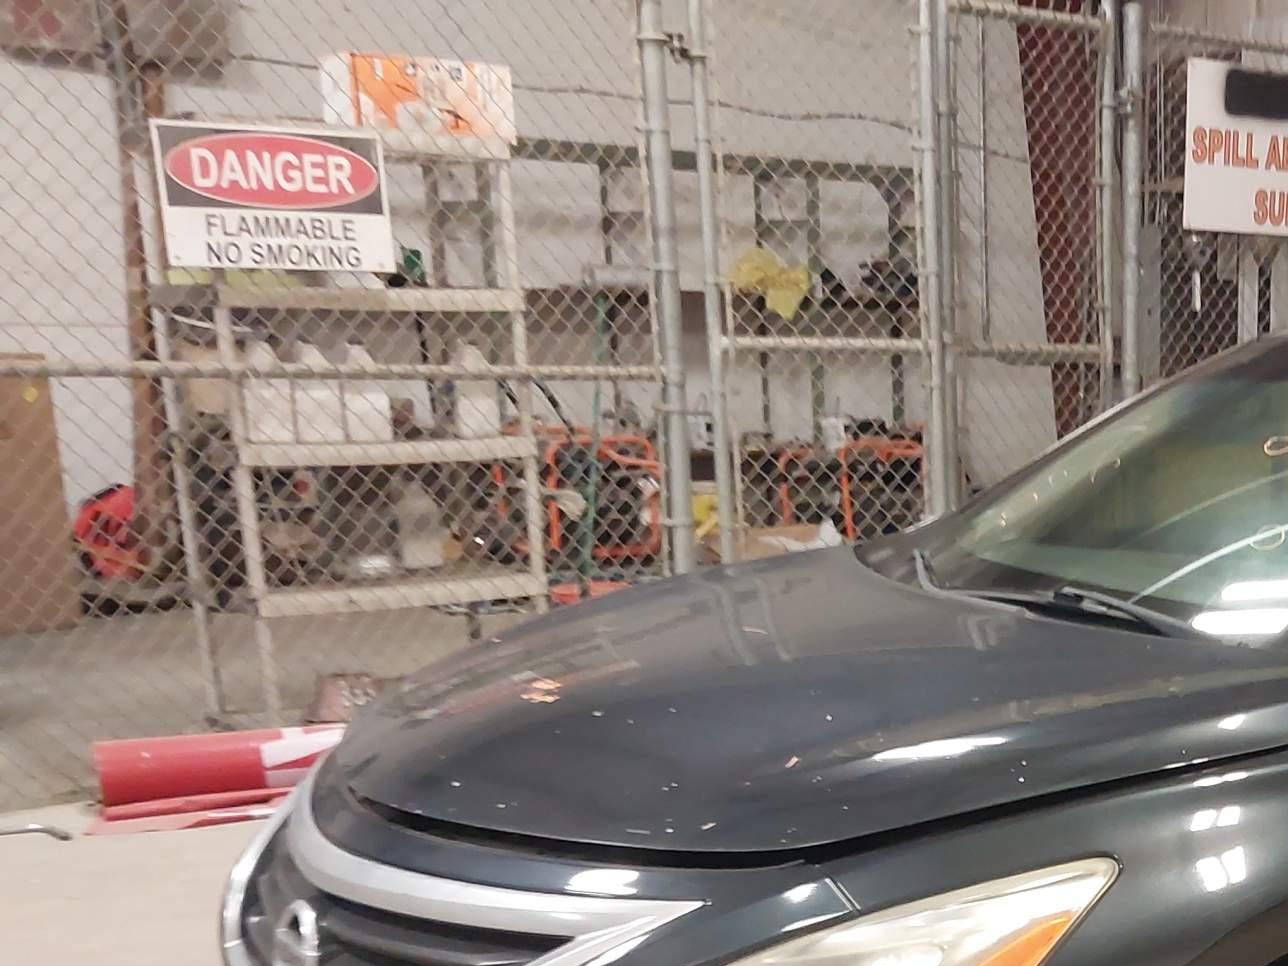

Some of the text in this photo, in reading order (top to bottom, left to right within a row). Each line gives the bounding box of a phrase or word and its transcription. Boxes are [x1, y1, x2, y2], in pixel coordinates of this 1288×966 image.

[1192, 127, 1259, 169] SPILL
[189, 148, 355, 194] DANGER
[205, 214, 357, 241] FLAMMABLE
[206, 242, 362, 268] NO SMOKING
